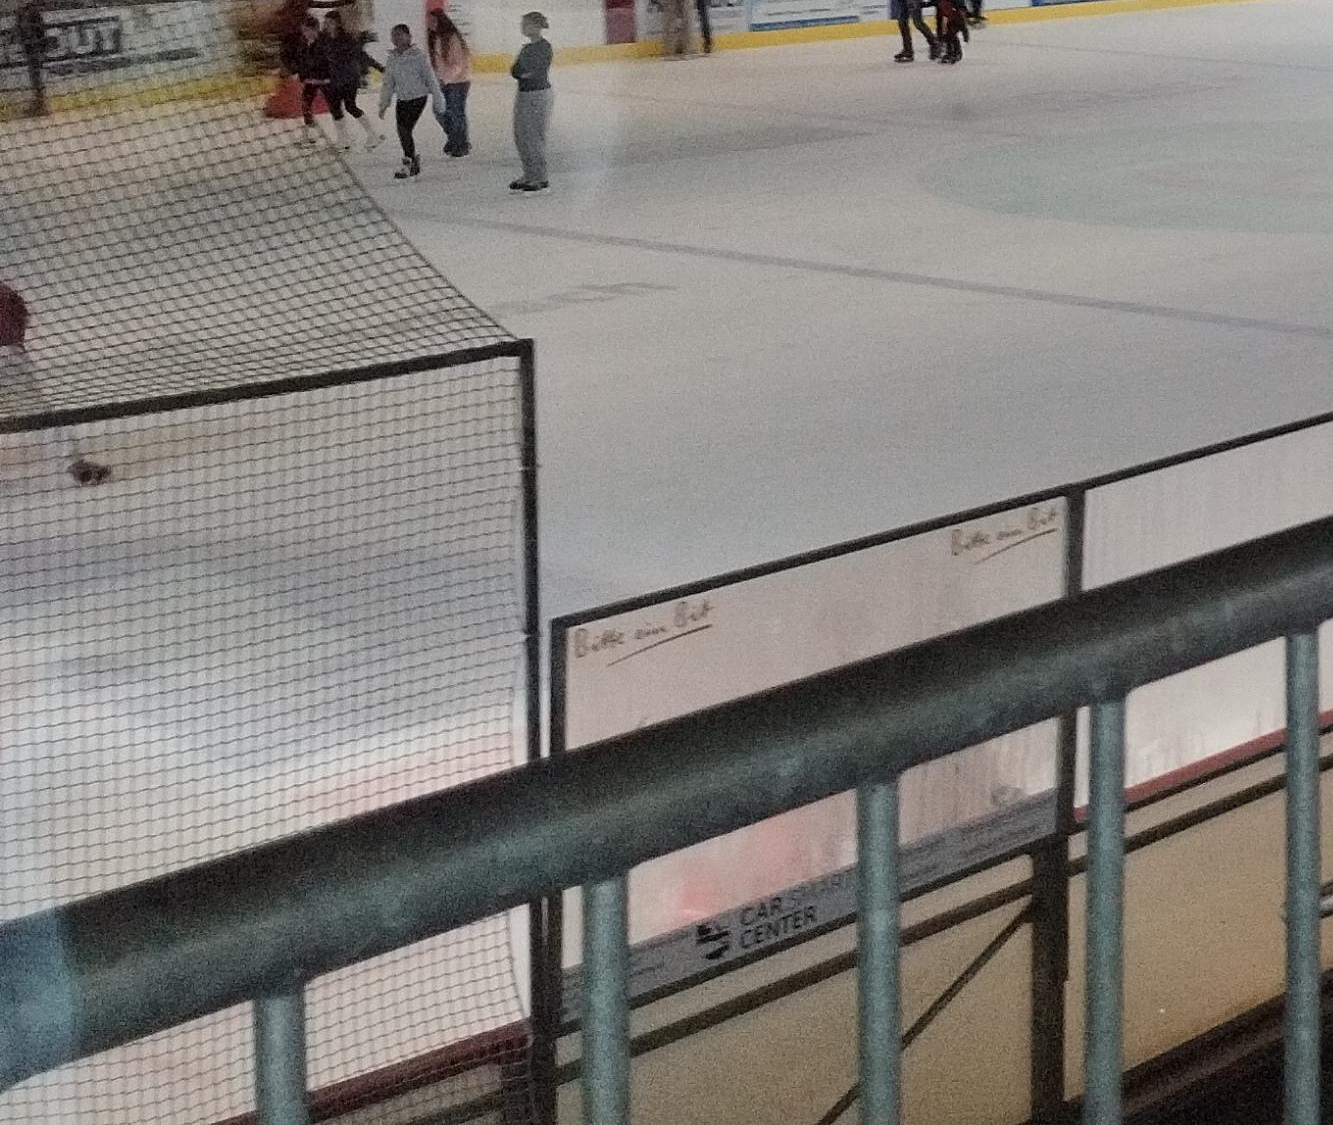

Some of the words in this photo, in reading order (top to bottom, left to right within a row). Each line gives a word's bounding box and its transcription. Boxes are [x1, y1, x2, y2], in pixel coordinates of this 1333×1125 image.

[575, 628, 625, 658] Bitte
[674, 599, 715, 627] Bit
[740, 896, 782, 925] CAR
[740, 905, 817, 949] CENTER
